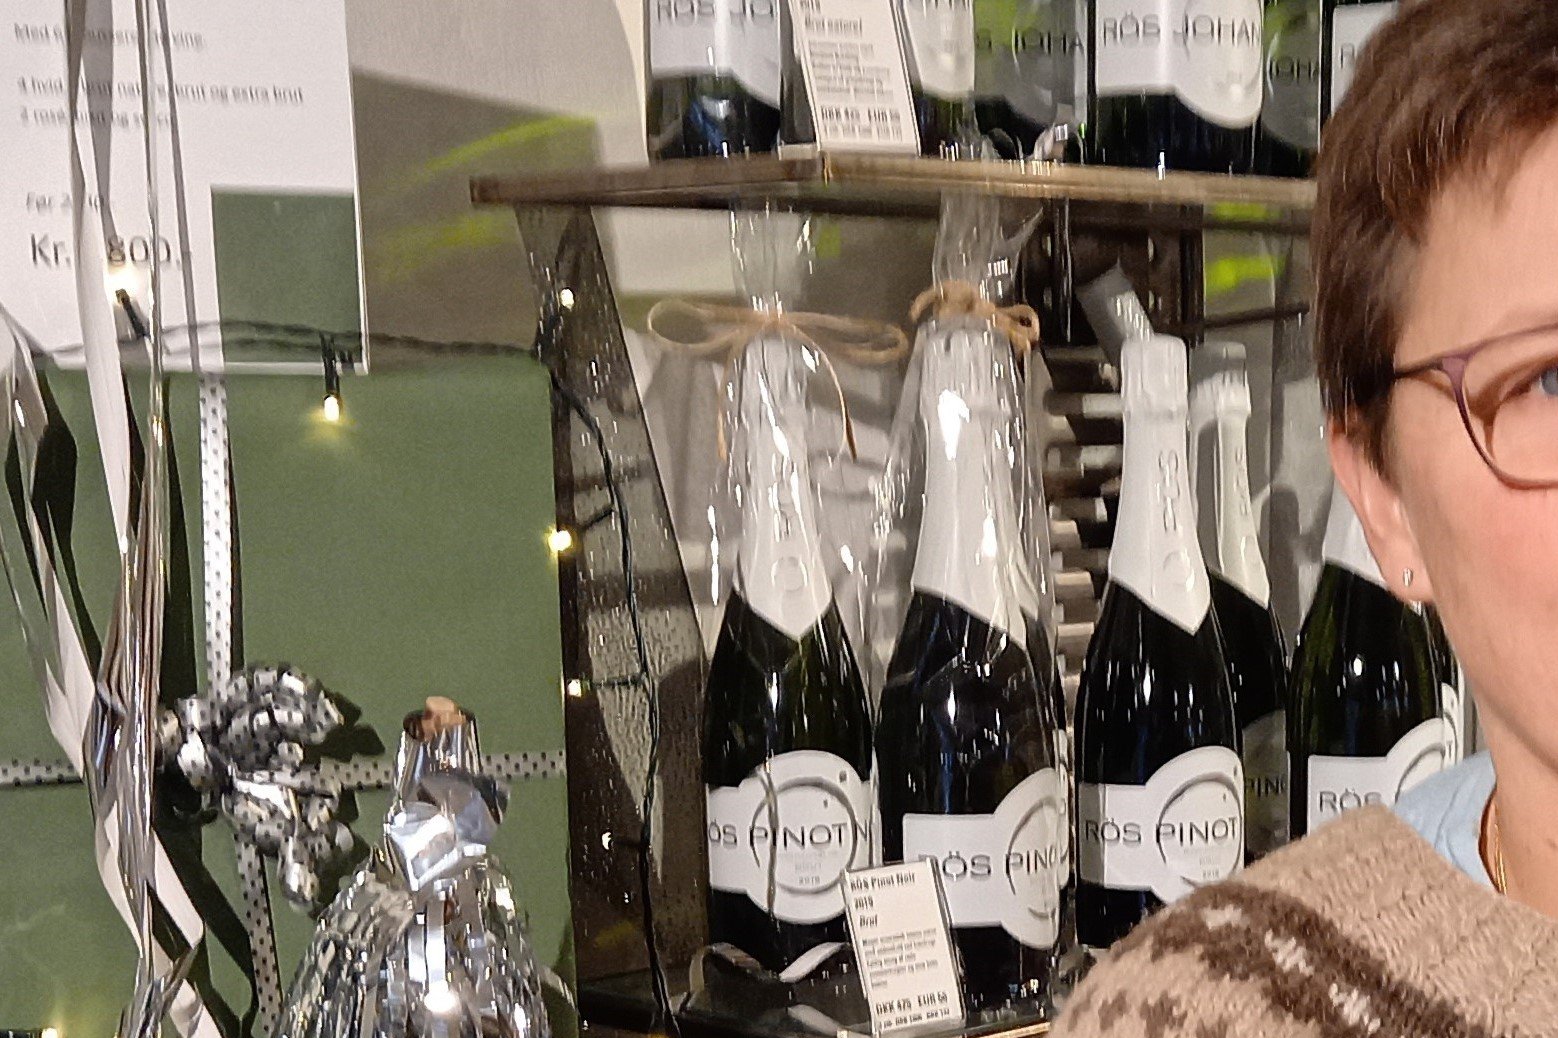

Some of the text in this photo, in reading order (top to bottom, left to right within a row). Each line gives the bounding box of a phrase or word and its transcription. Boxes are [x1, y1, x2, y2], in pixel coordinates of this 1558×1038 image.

[1103, 11, 1160, 47] RÖS
[31, 233, 71, 267] Kr.
[708, 818, 737, 848] ÖS
[750, 822, 847, 850] PINOT
[1085, 816, 1237, 847] RÖS PINOT
[919, 845, 1057, 879] ÖS PIN
